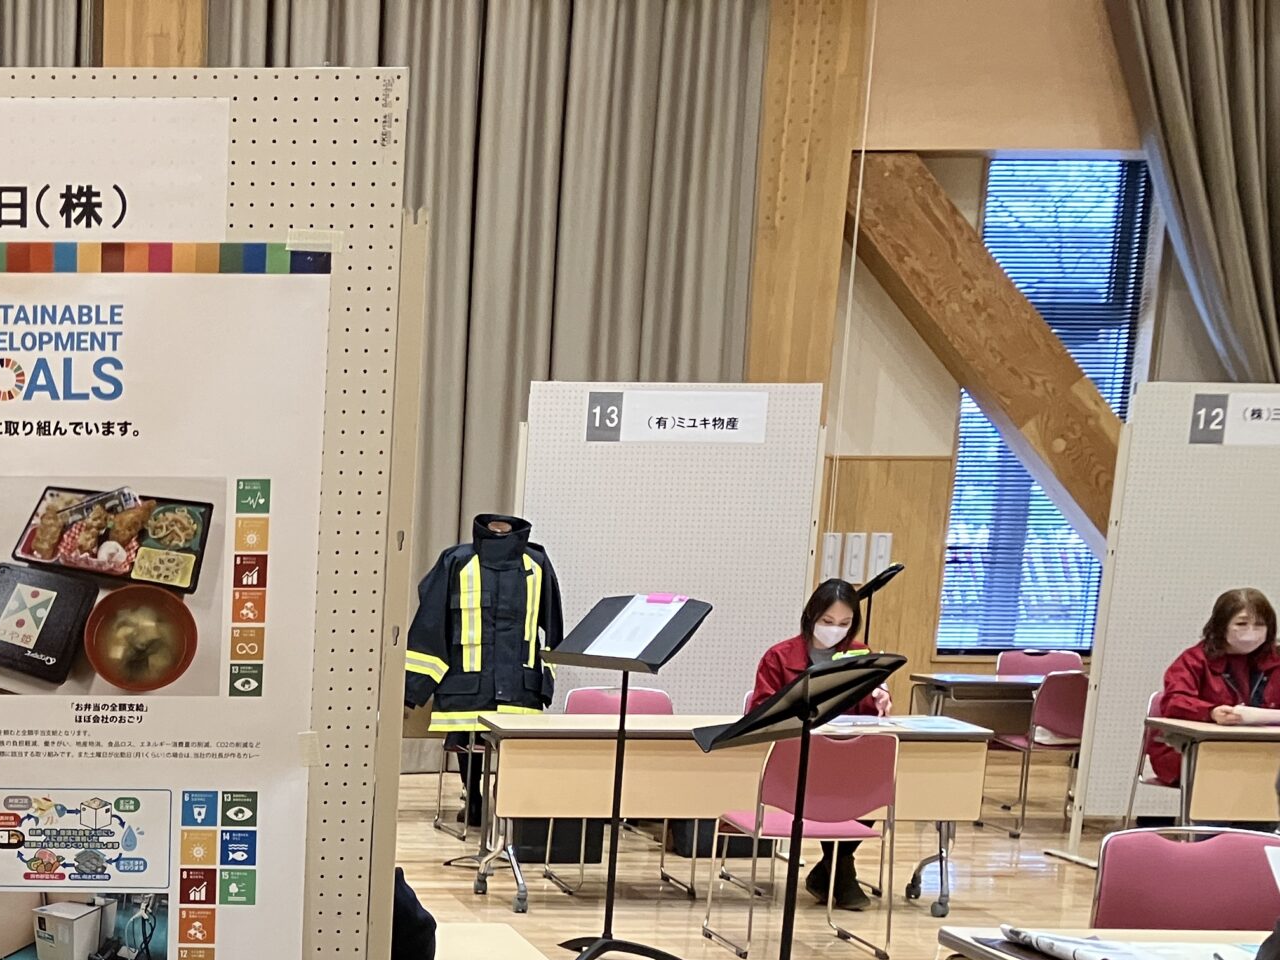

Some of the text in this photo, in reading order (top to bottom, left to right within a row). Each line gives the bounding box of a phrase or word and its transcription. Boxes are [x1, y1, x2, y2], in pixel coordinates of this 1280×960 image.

[592, 406, 618, 428] 13
[647, 416, 738, 430] （有）ミユキ物産
[1196, 408, 1224, 430] 12
[70, 702, 148, 712] 「お弁当の全額支給」
[74, 715, 143, 724] ほぼ会社のおごり
